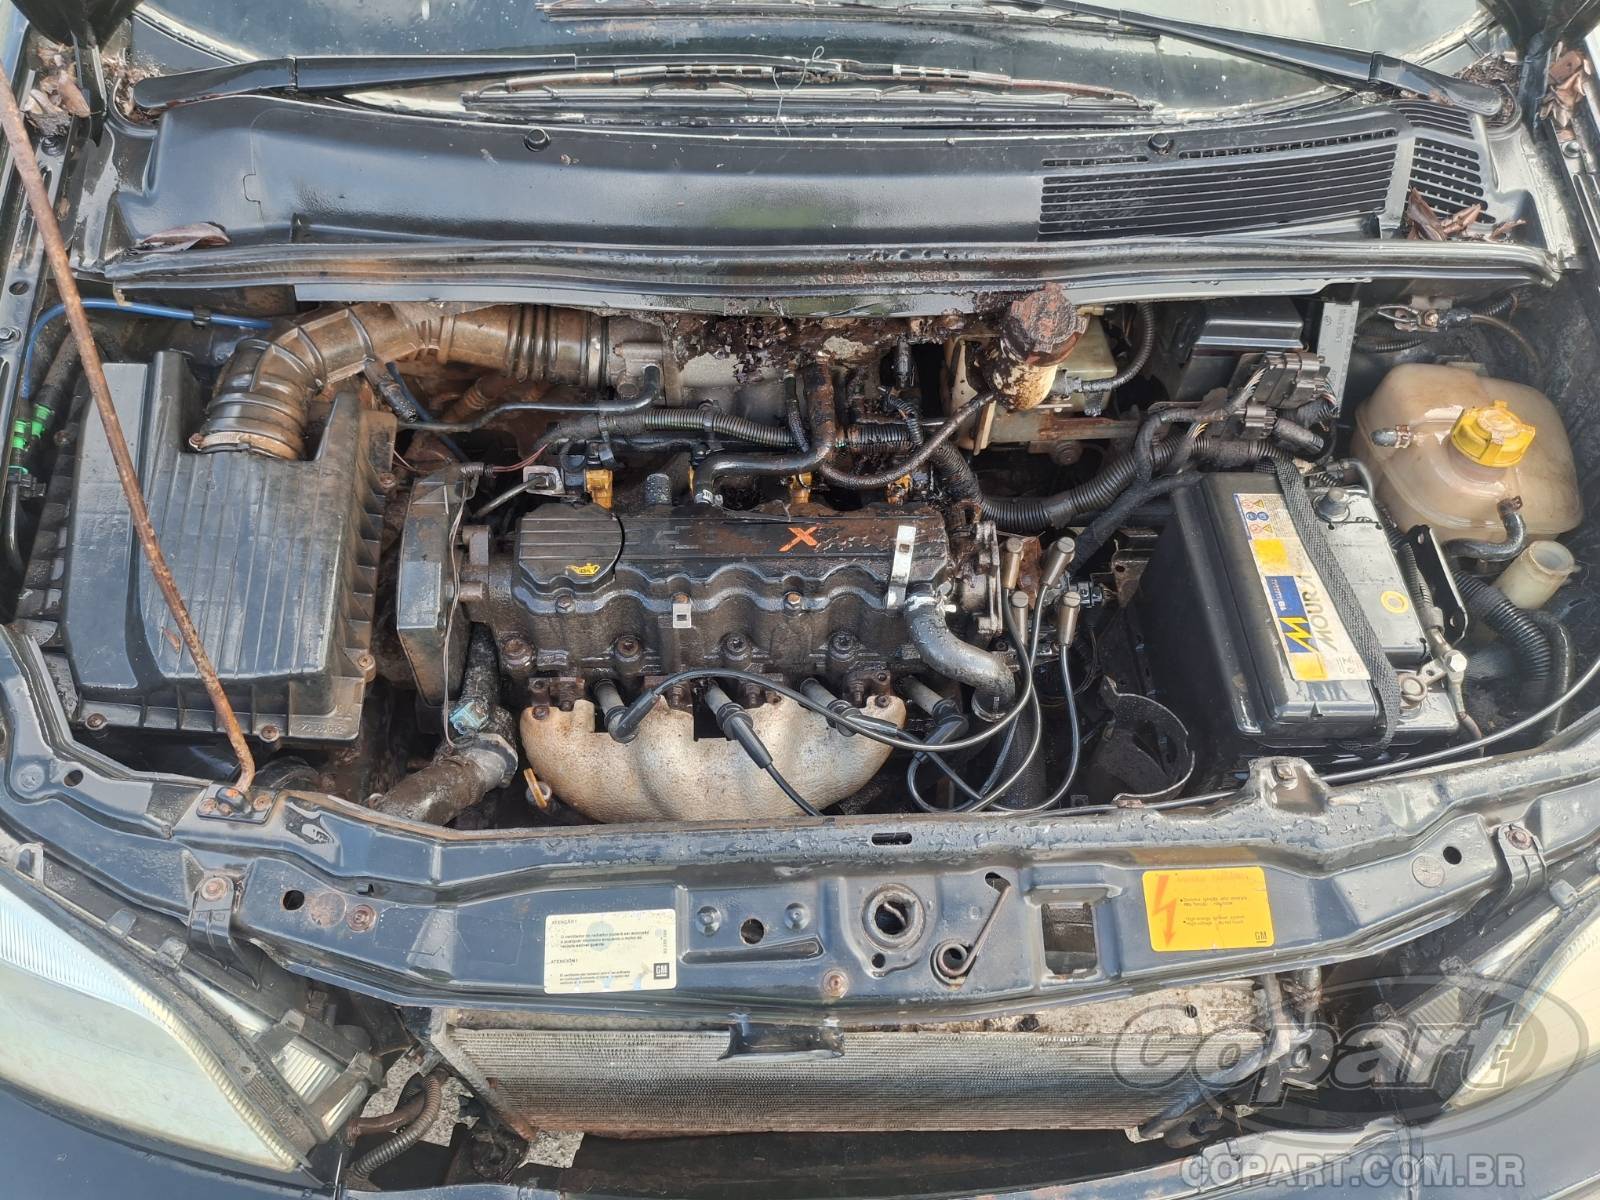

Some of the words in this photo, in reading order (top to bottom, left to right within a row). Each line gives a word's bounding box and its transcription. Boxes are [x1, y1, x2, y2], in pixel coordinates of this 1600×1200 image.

[1297, 574, 1338, 652] MOURA
[1255, 932, 1267, 940] GM
[655, 964, 668, 977] GM
